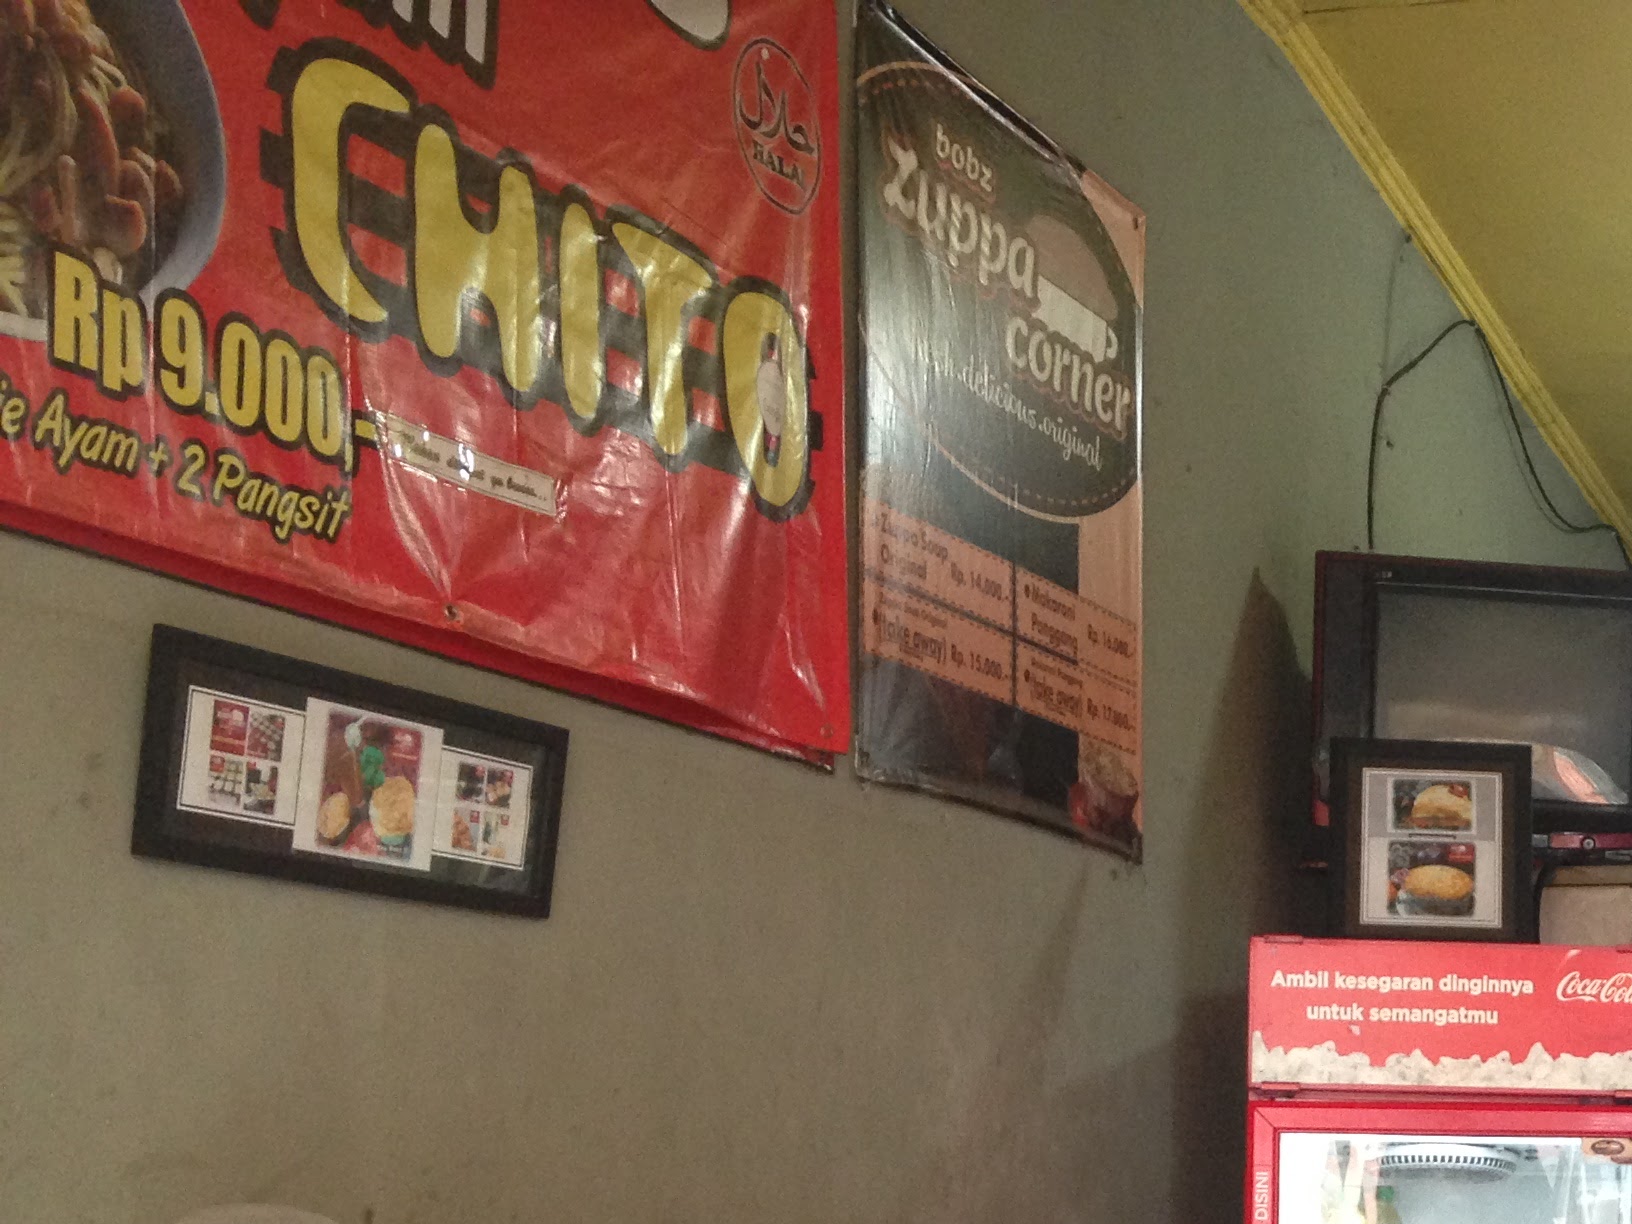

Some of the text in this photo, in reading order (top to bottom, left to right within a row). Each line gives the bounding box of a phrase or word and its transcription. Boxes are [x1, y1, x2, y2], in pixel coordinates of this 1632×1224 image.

[54, 250, 145, 392] Rp
[288, 55, 810, 510] CHITO
[35, 393, 139, 473] Ayam
[148, 441, 169, 473] +
[176, 444, 206, 494] 2
[213, 454, 350, 540] Pangsit
[1270, 969, 1534, 997] Ambil kesegaran dinginnya
[1306, 1002, 1499, 1027] untuk semangatmu
[1253, 1171, 1269, 1221] DISINI
